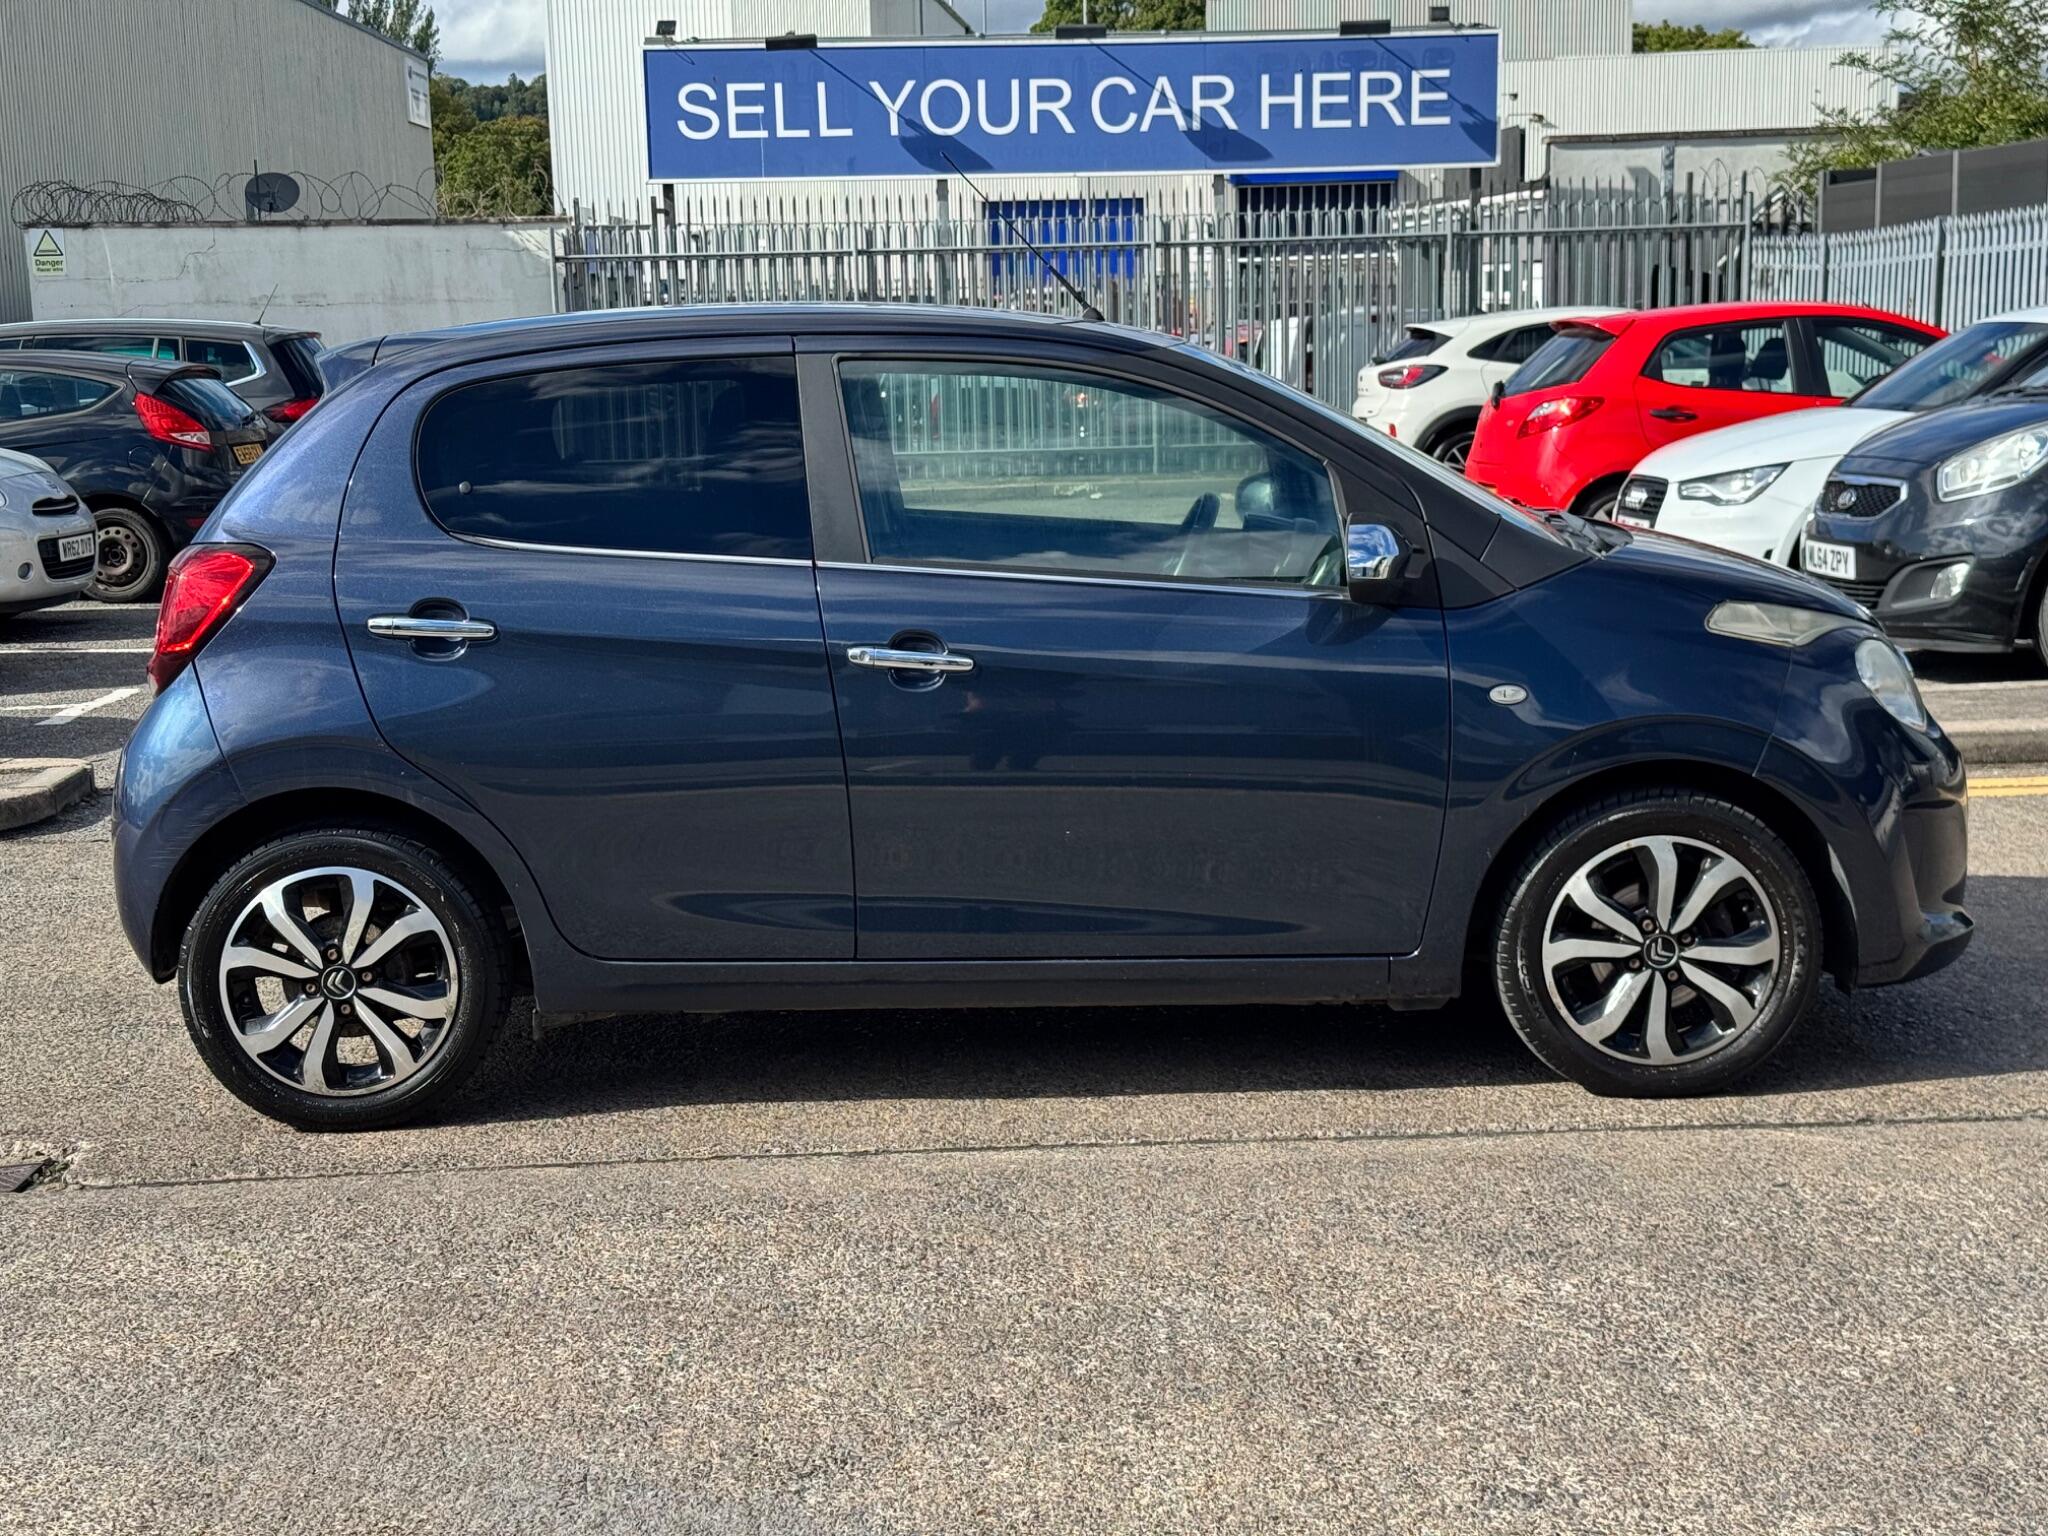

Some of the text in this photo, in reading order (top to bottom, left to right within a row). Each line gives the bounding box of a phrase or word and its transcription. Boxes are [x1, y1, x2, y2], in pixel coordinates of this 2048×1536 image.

[677, 69, 1451, 140] SELL YOUR CAR HERE
[35, 259, 64, 267] Danger
[1829, 549, 1848, 574] ZPY
